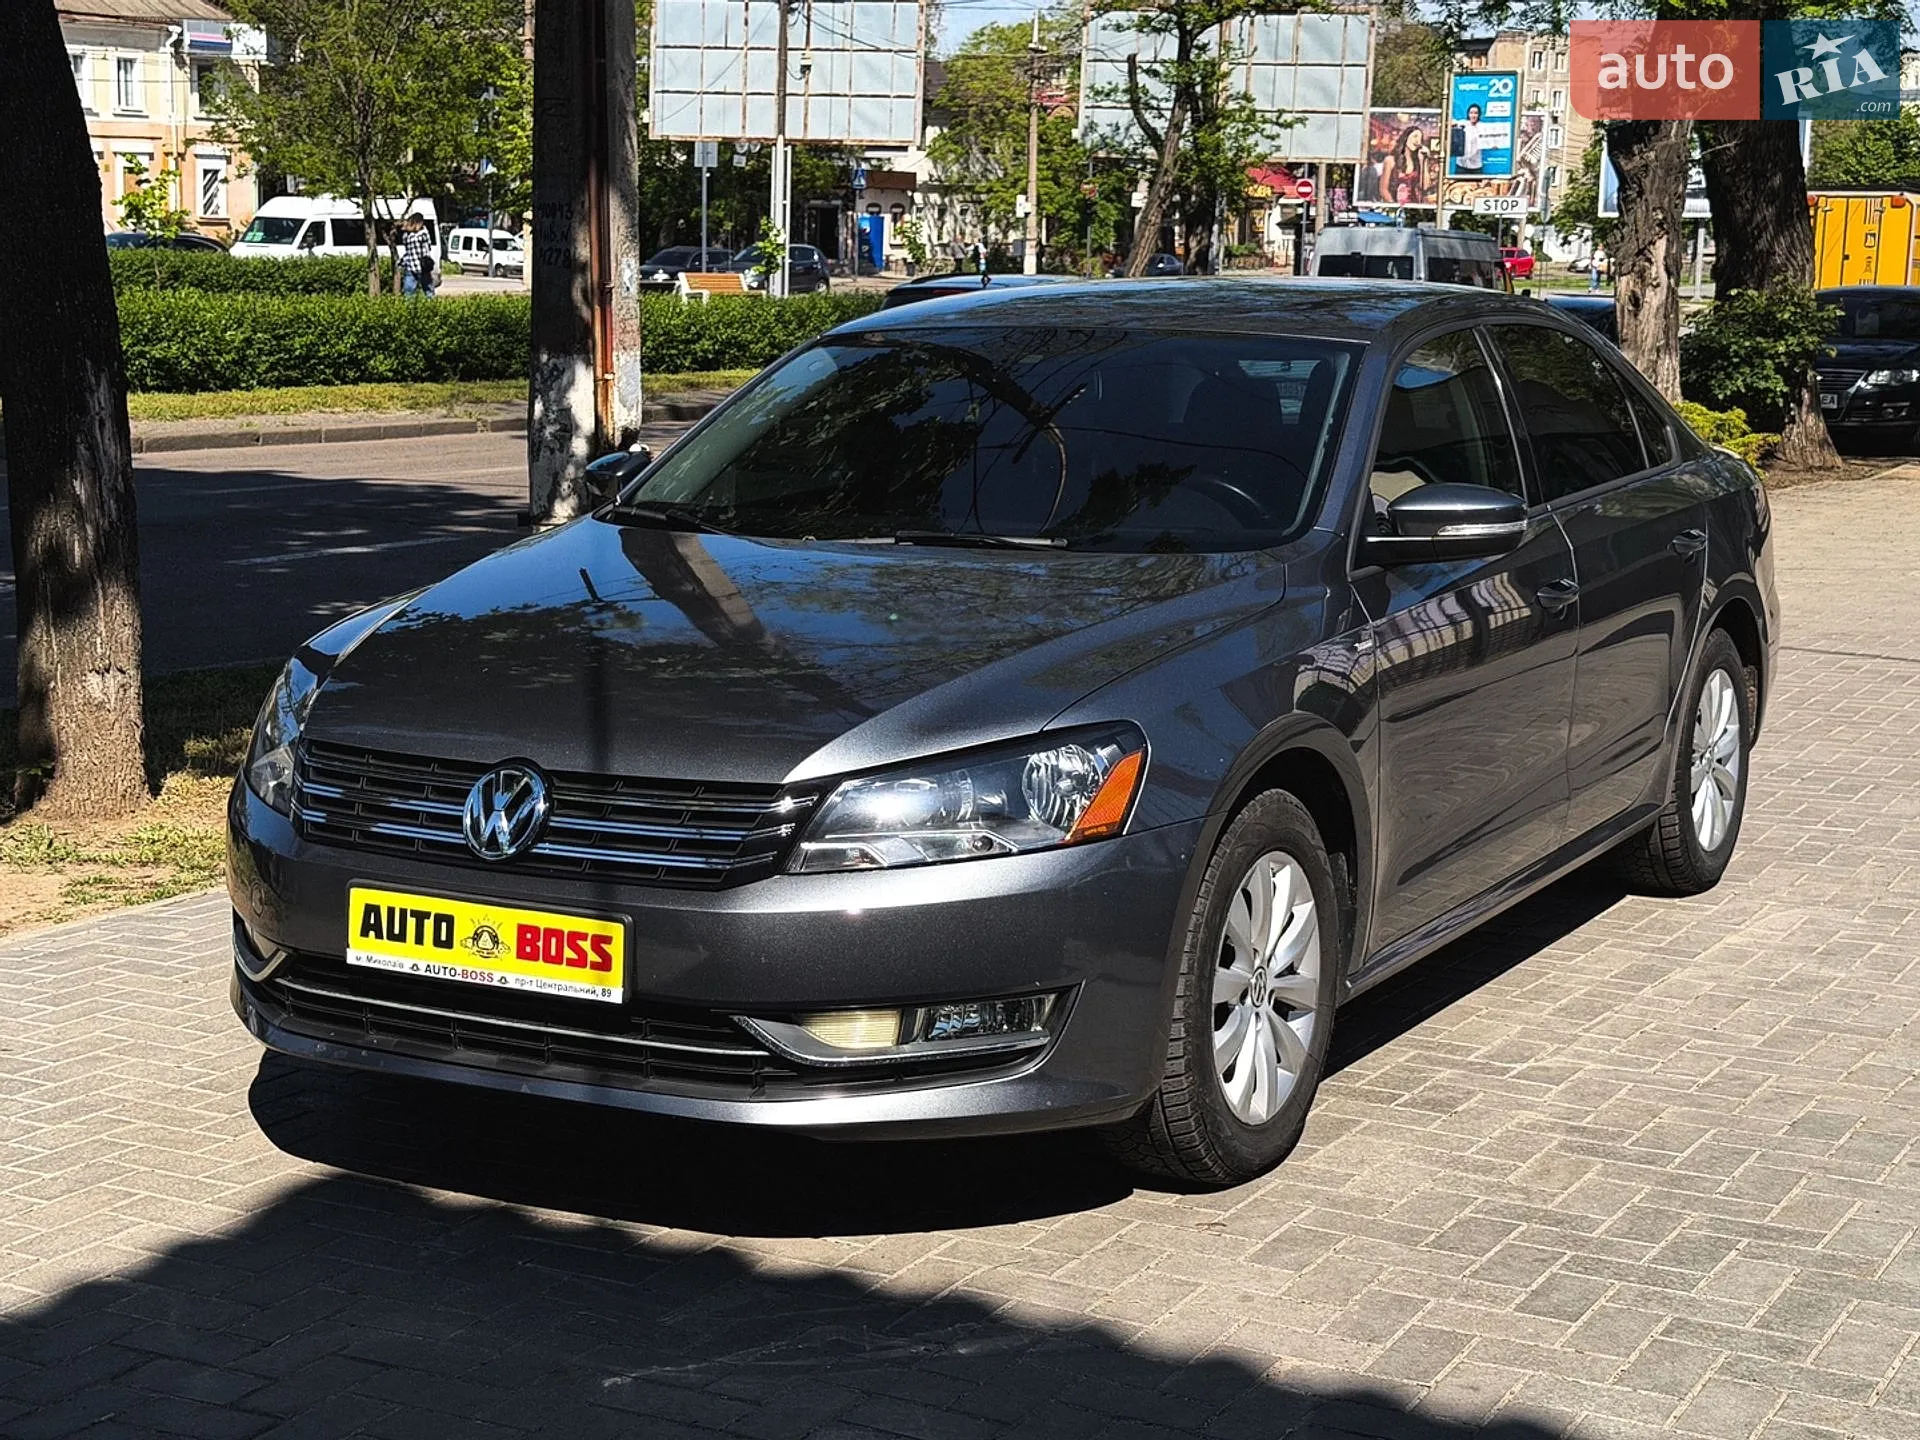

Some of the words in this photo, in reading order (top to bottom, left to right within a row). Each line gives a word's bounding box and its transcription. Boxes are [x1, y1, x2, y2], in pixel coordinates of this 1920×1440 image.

[1488, 78, 1513, 97] 20
[1483, 199, 1519, 211] STOP
[360, 903, 455, 950] AUTO
[516, 923, 613, 973] BOSS
[424, 964, 494, 983] AUTO-BOSS
[601, 988, 612, 998] 89
